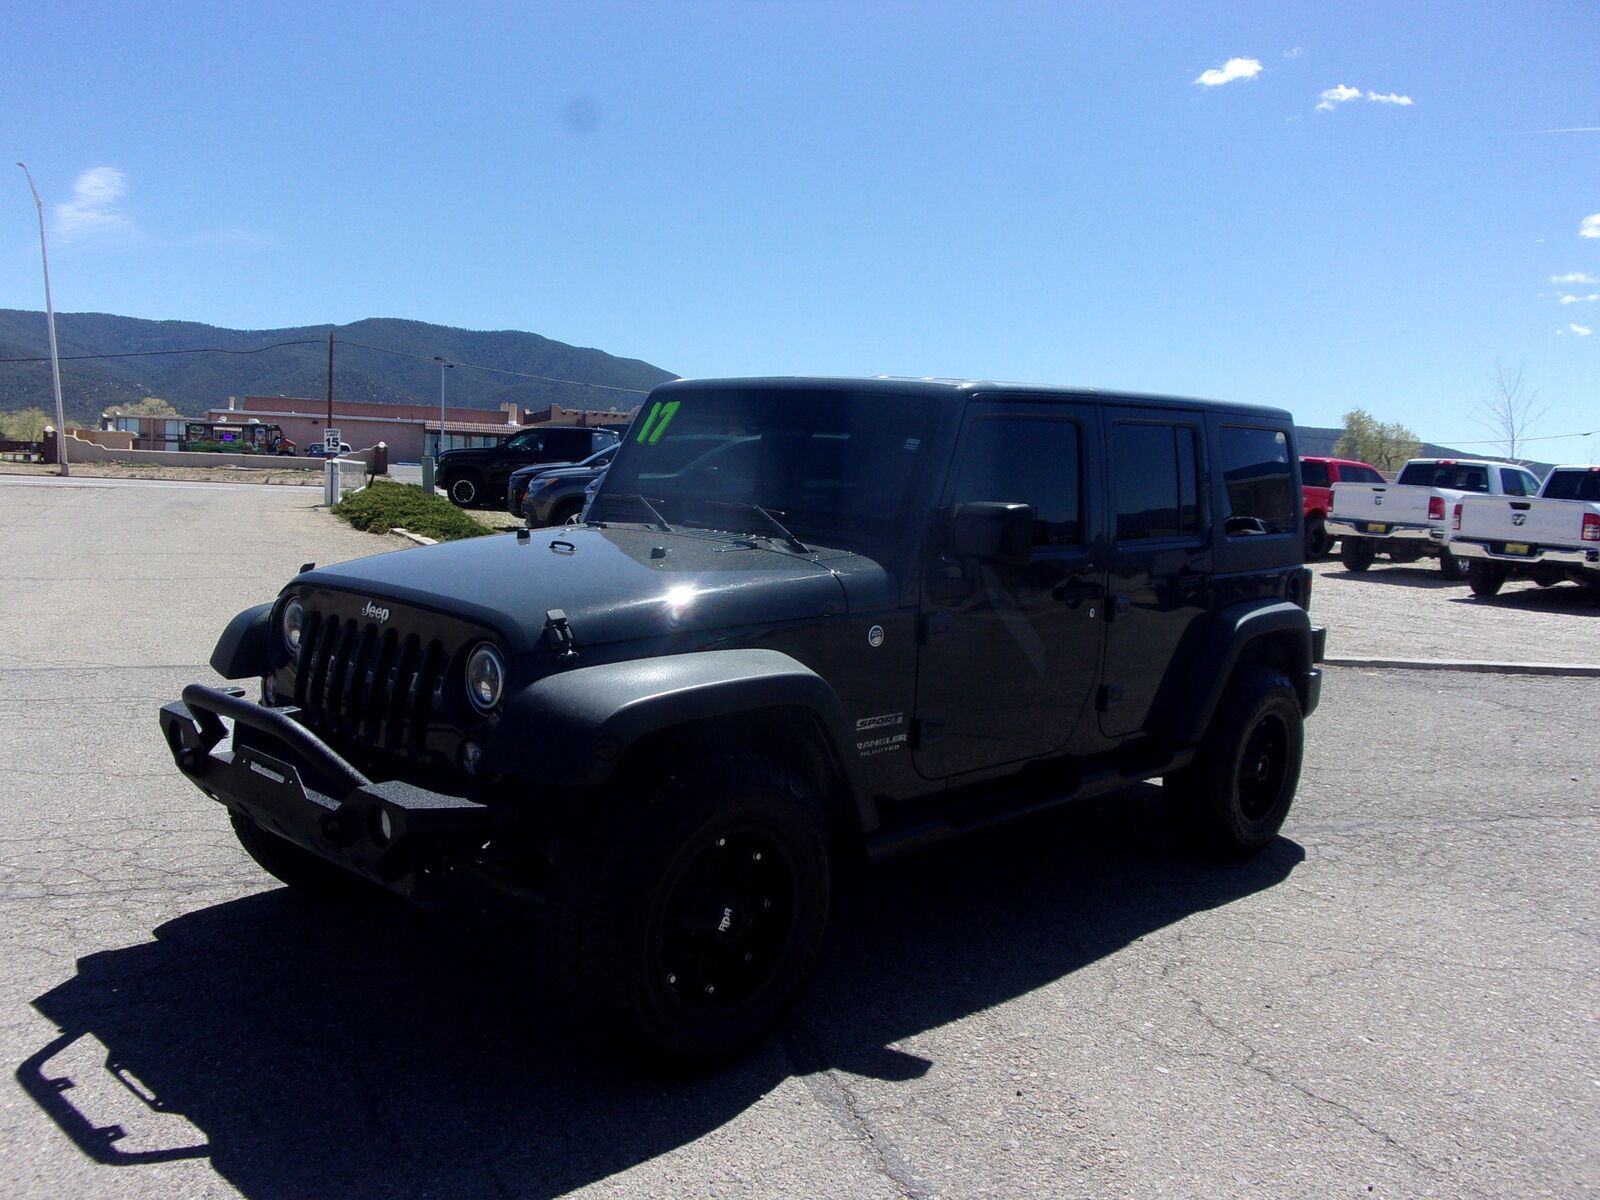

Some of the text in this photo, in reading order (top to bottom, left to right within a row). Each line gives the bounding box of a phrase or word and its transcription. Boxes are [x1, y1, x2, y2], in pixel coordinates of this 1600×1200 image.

[636, 401, 680, 443] 17
[326, 438, 339, 447] 15
[361, 600, 390, 624] Jeep
